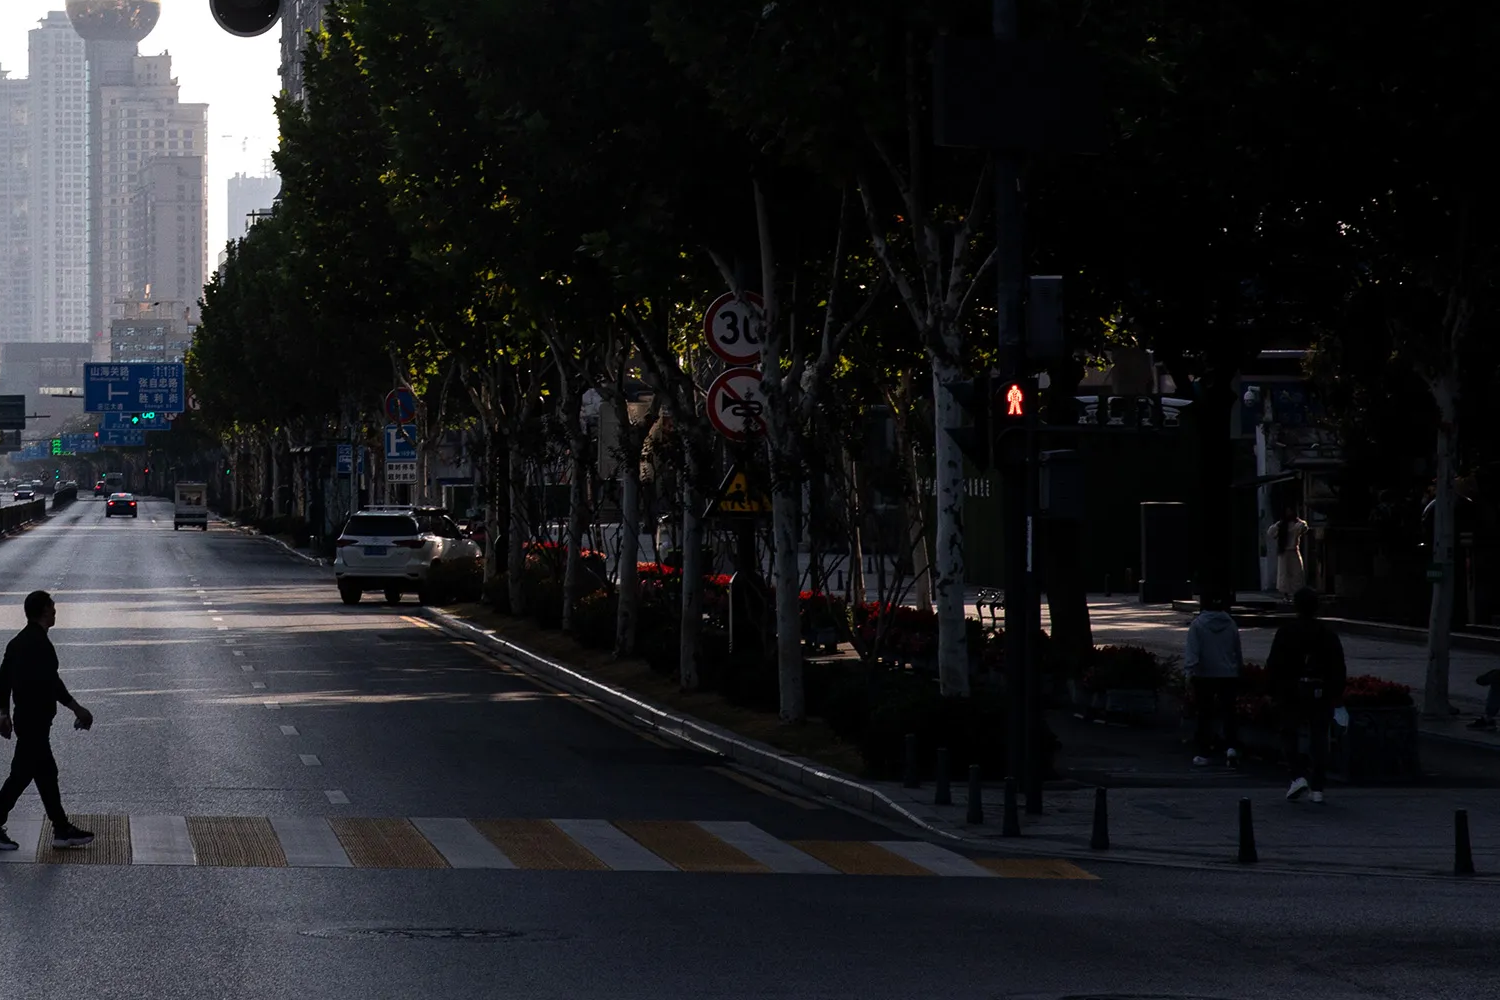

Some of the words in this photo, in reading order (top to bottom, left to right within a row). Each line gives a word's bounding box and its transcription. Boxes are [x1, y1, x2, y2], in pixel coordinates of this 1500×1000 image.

[90, 366, 130, 377] 山海关路
[138, 378, 178, 388] 张自忠路
[138, 393, 178, 404] 胜利街
